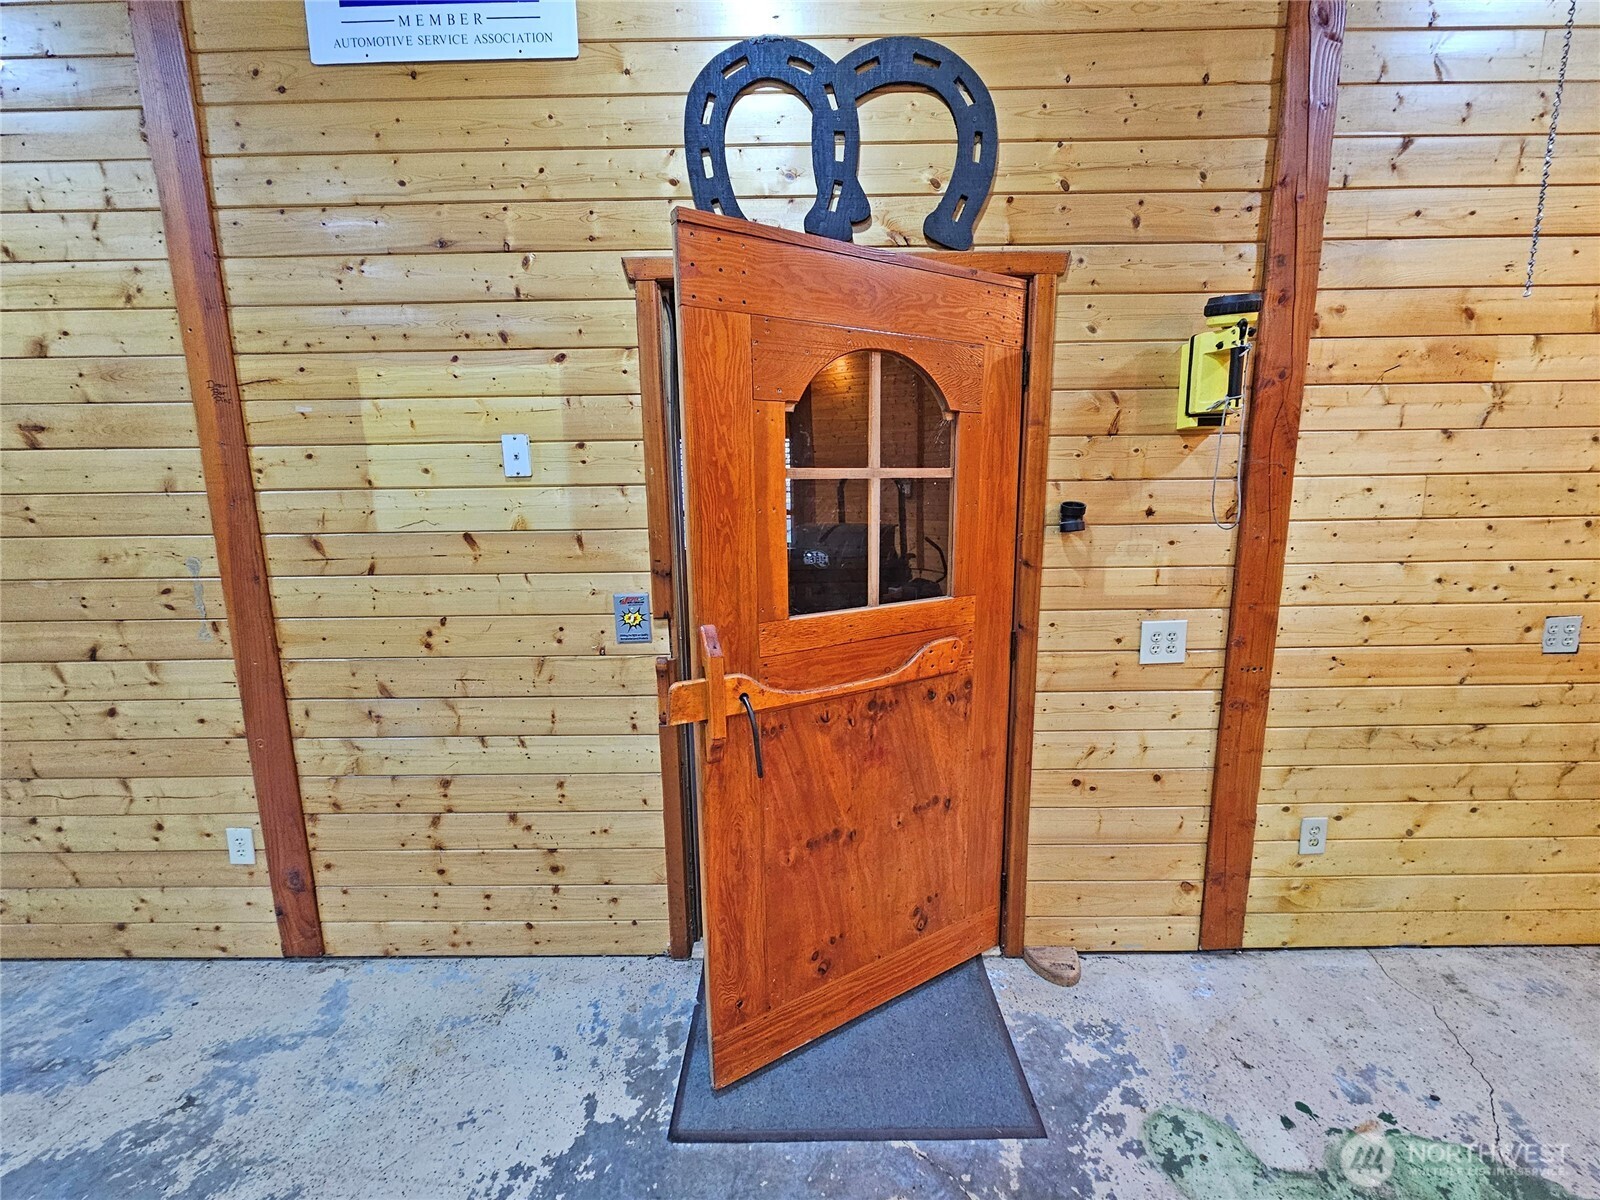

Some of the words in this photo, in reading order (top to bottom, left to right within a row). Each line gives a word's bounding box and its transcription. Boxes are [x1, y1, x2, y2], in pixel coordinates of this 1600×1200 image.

[398, 12, 483, 27] MEMBER
[333, 35, 414, 49] AUTOMOTIVE
[417, 33, 469, 46] SERVICE
[473, 31, 553, 45] ASSOCIATION
